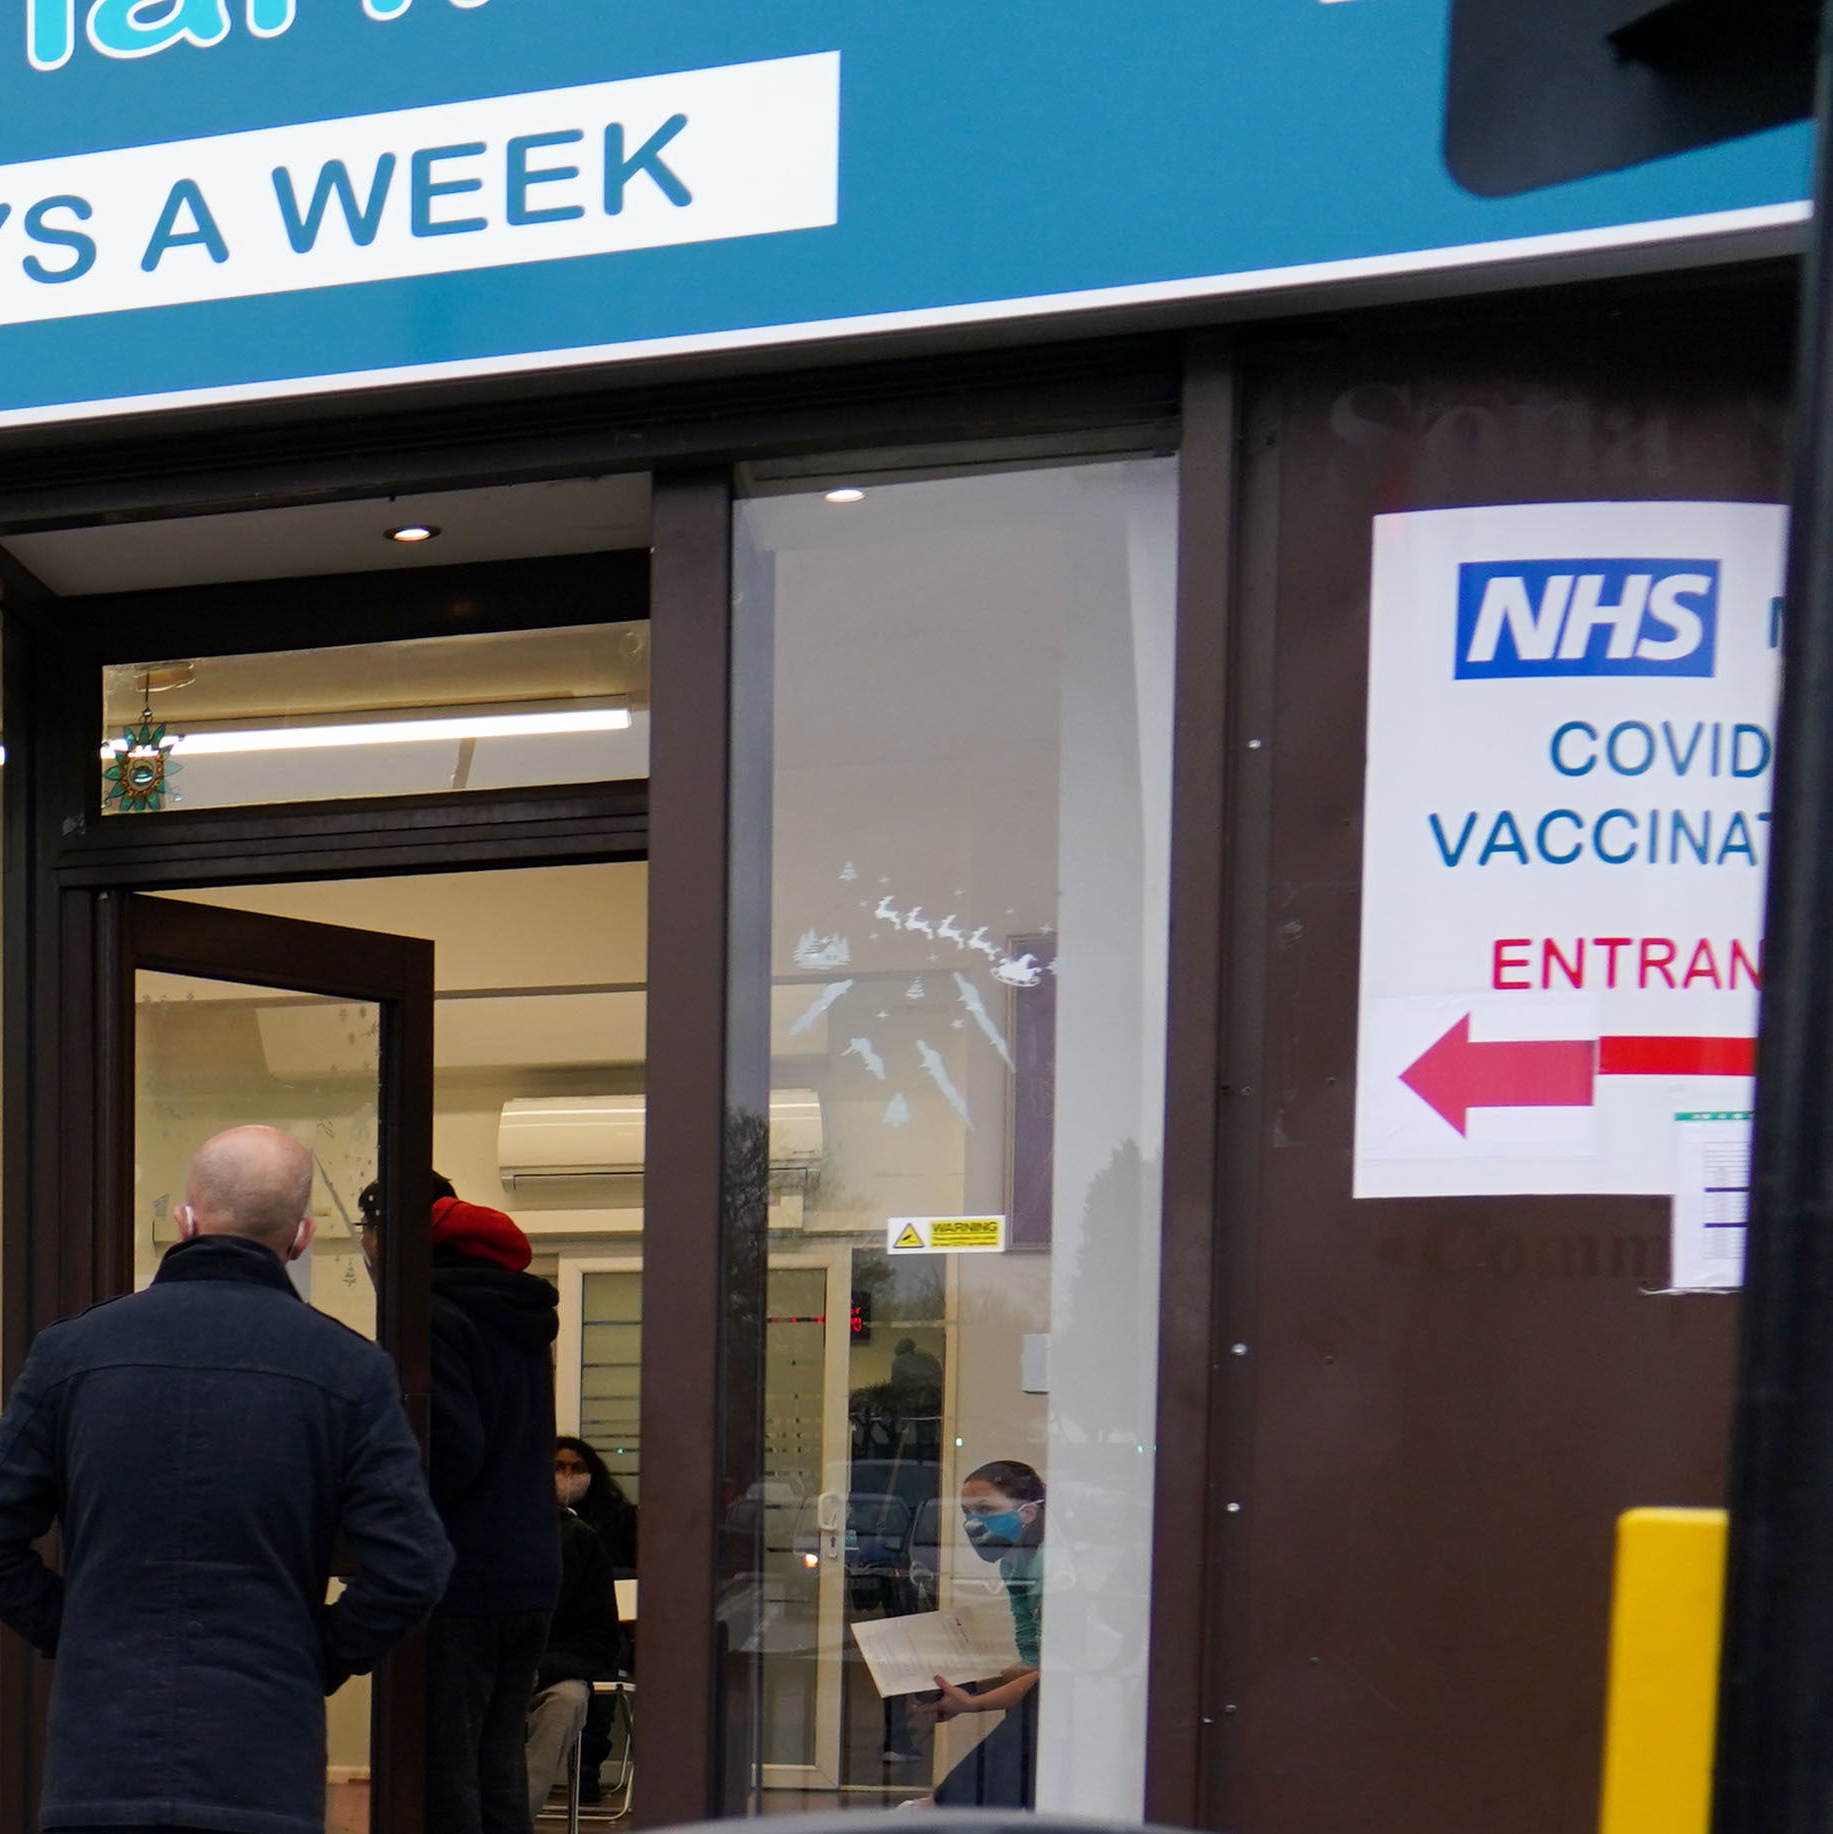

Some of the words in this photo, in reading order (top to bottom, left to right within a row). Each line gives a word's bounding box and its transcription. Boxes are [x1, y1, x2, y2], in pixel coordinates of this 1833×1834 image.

[141, 180, 229, 272] A
[272, 114, 692, 253] WEEK
[1467, 574, 1713, 661] NHS
[1549, 720, 1771, 778] COVID
[932, 1221, 998, 1233] WARNING
